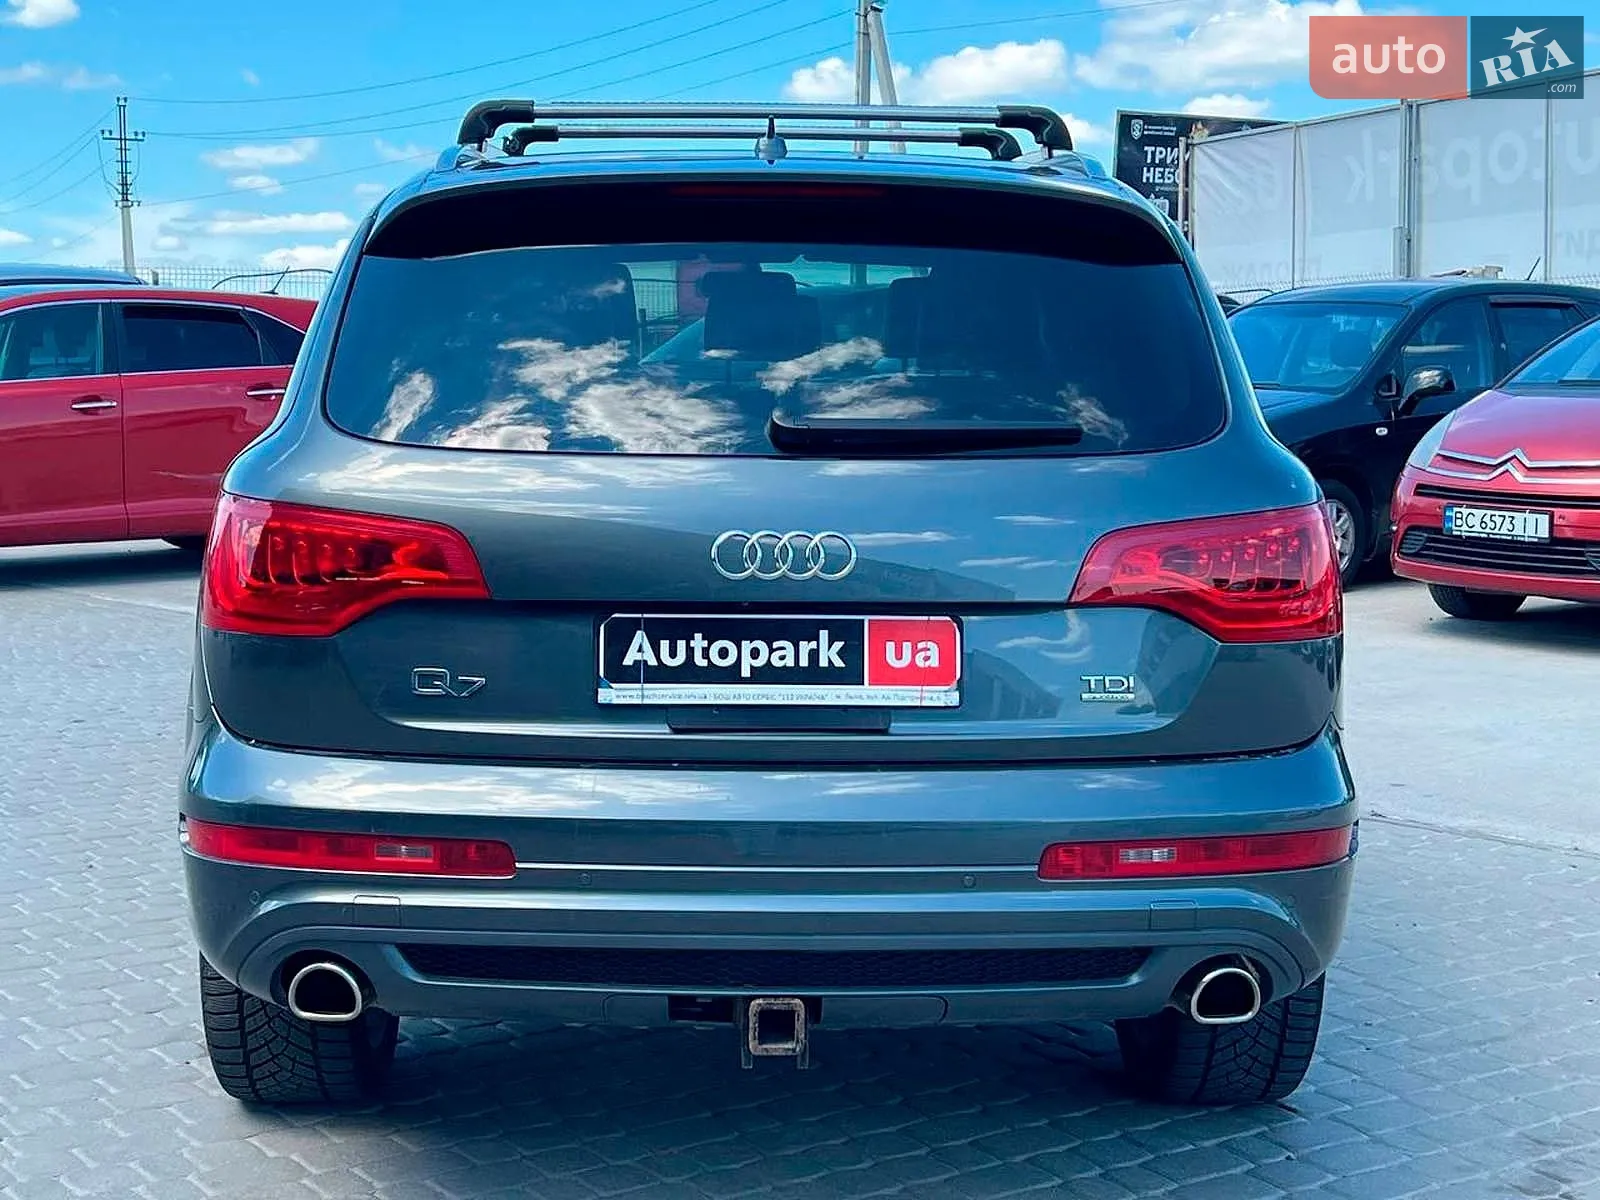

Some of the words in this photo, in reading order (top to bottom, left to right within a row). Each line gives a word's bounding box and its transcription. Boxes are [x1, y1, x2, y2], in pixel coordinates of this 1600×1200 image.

[1454, 511, 1475, 529] BC
[1479, 513, 1515, 532] 6573
[622, 629, 846, 678] Autopark
[884, 639, 940, 667] ua
[411, 667, 486, 697] Q7
[1080, 675, 1134, 692] TDI
